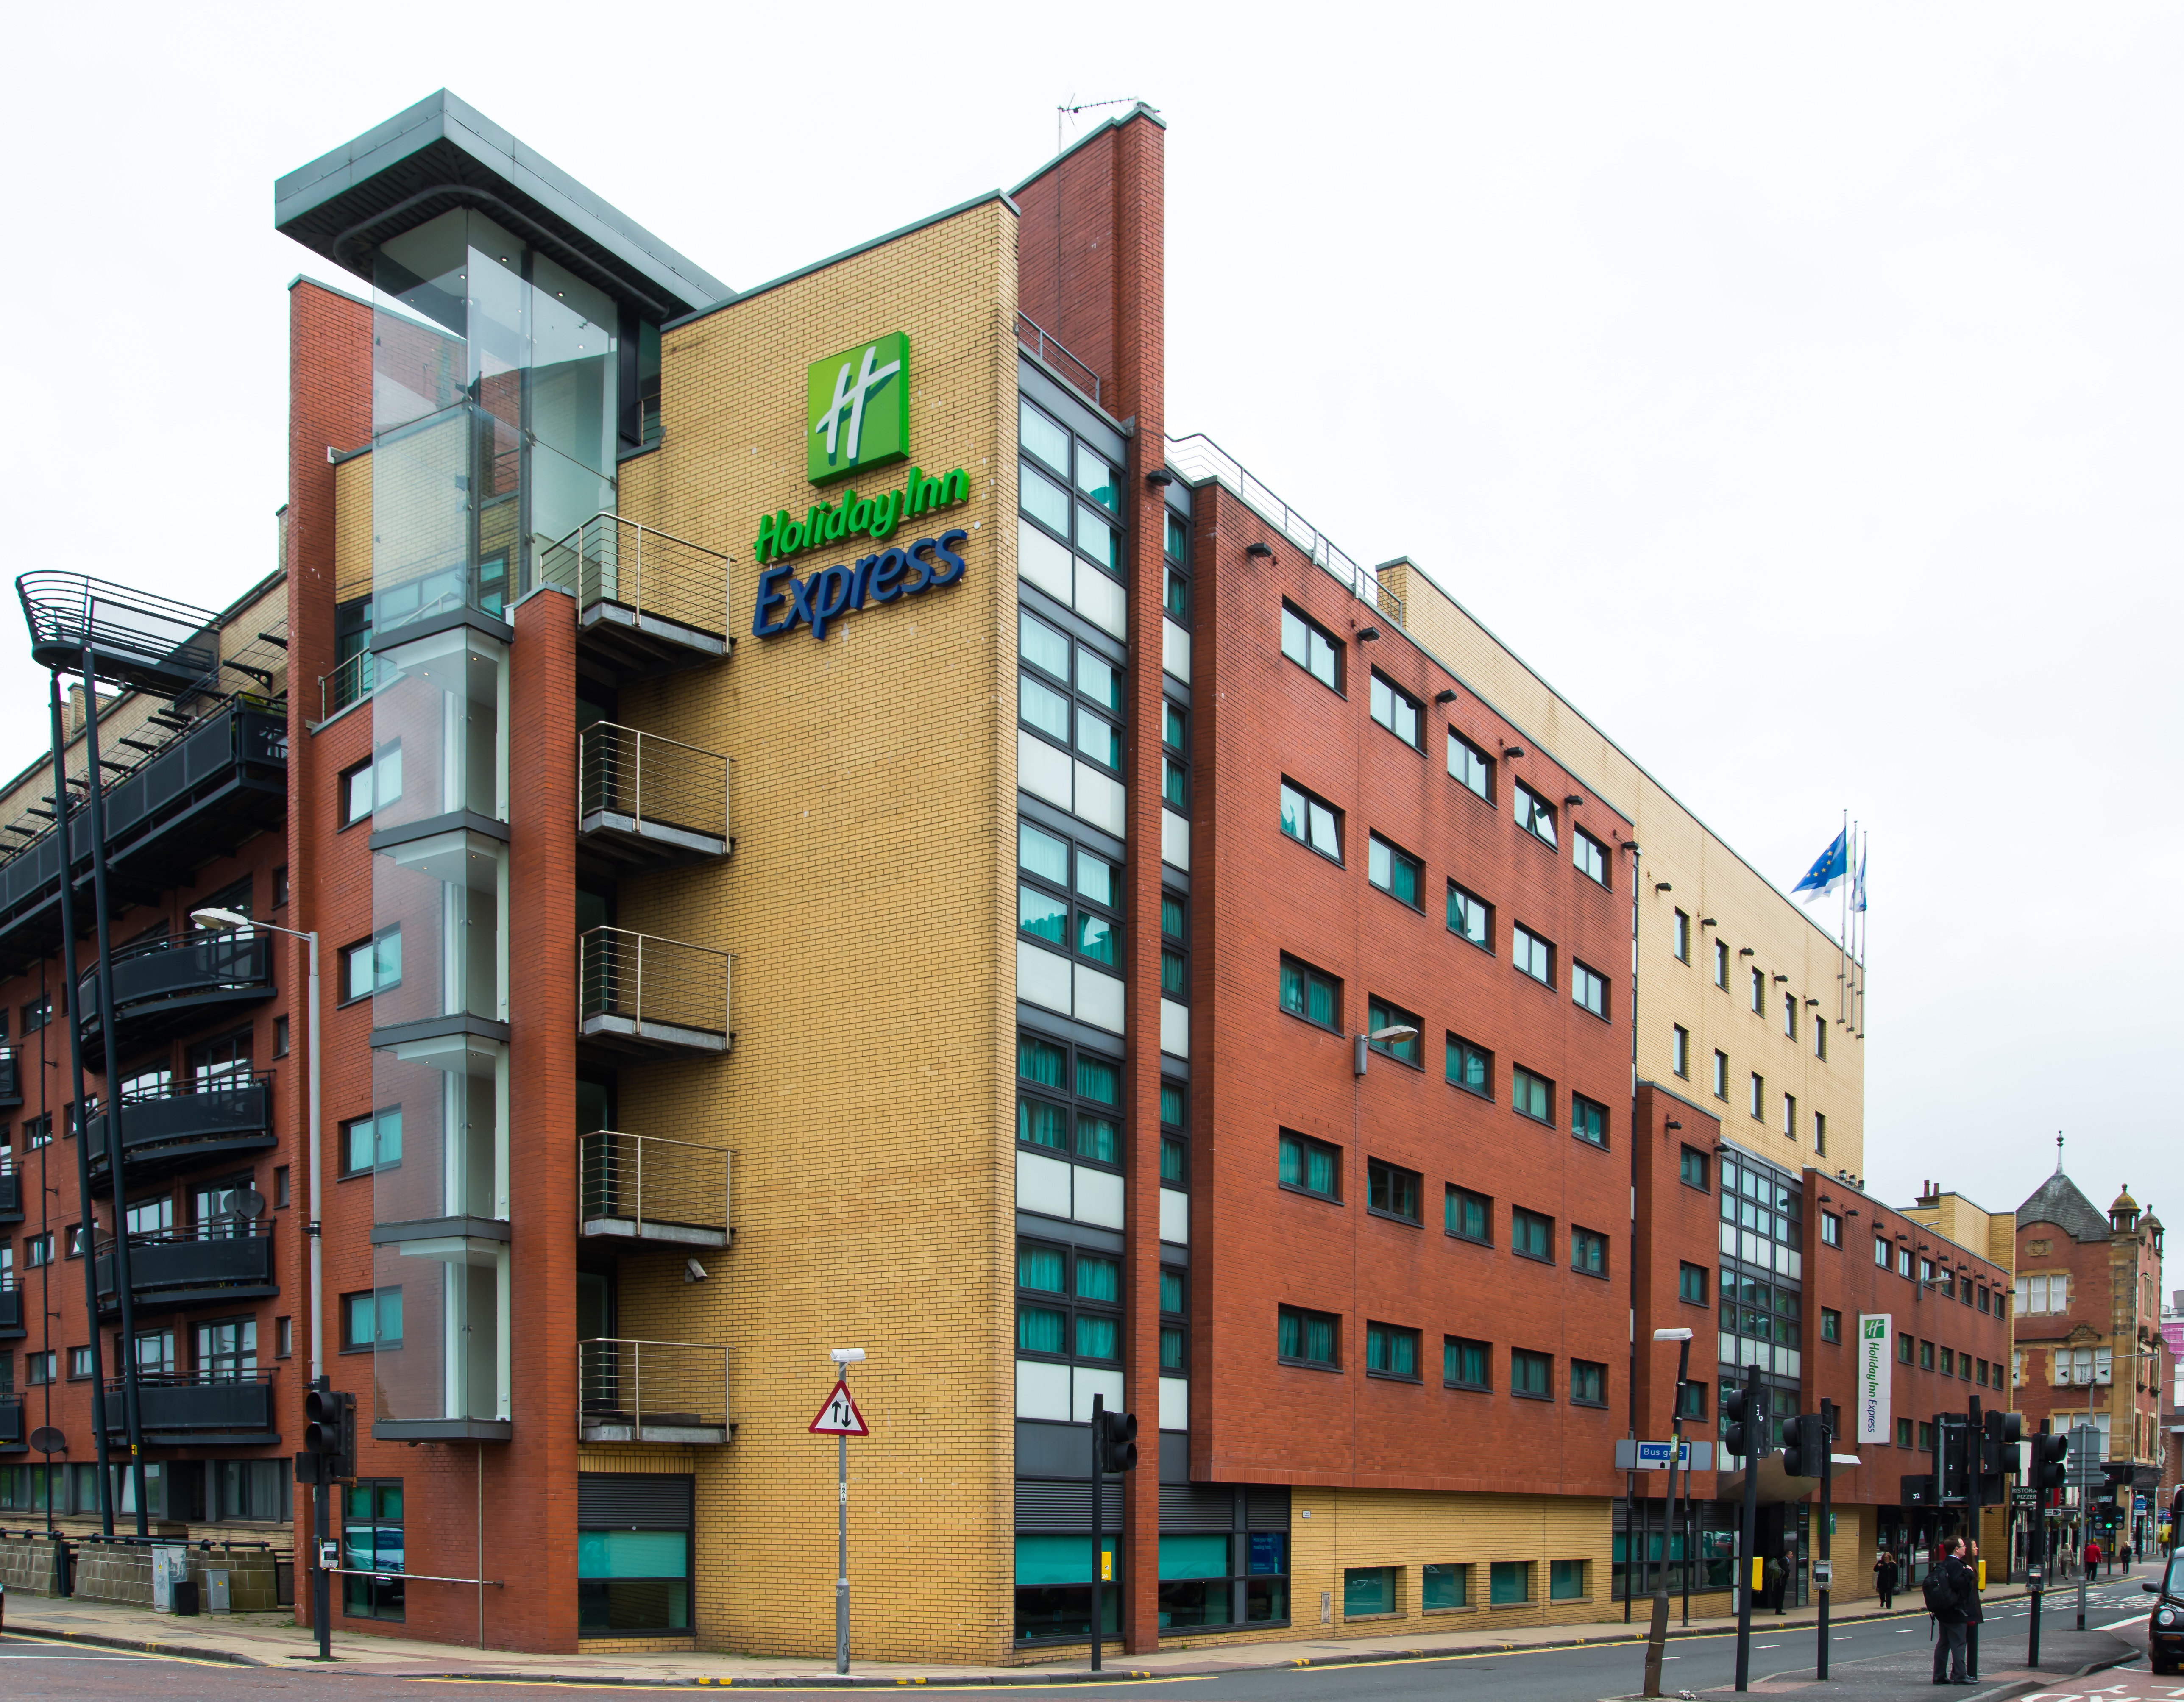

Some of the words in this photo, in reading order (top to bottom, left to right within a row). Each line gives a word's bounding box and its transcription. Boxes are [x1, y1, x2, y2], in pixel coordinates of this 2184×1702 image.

[753, 489, 903, 564] Holiday
[903, 467, 970, 518] Inn
[752, 529, 968, 640] Express
[1866, 1342, 1879, 1380] Holiday
[1869, 1382, 1879, 1397] Inn
[1866, 1399, 1877, 1433] Express
[1644, 1448, 1660, 1456] Bus
